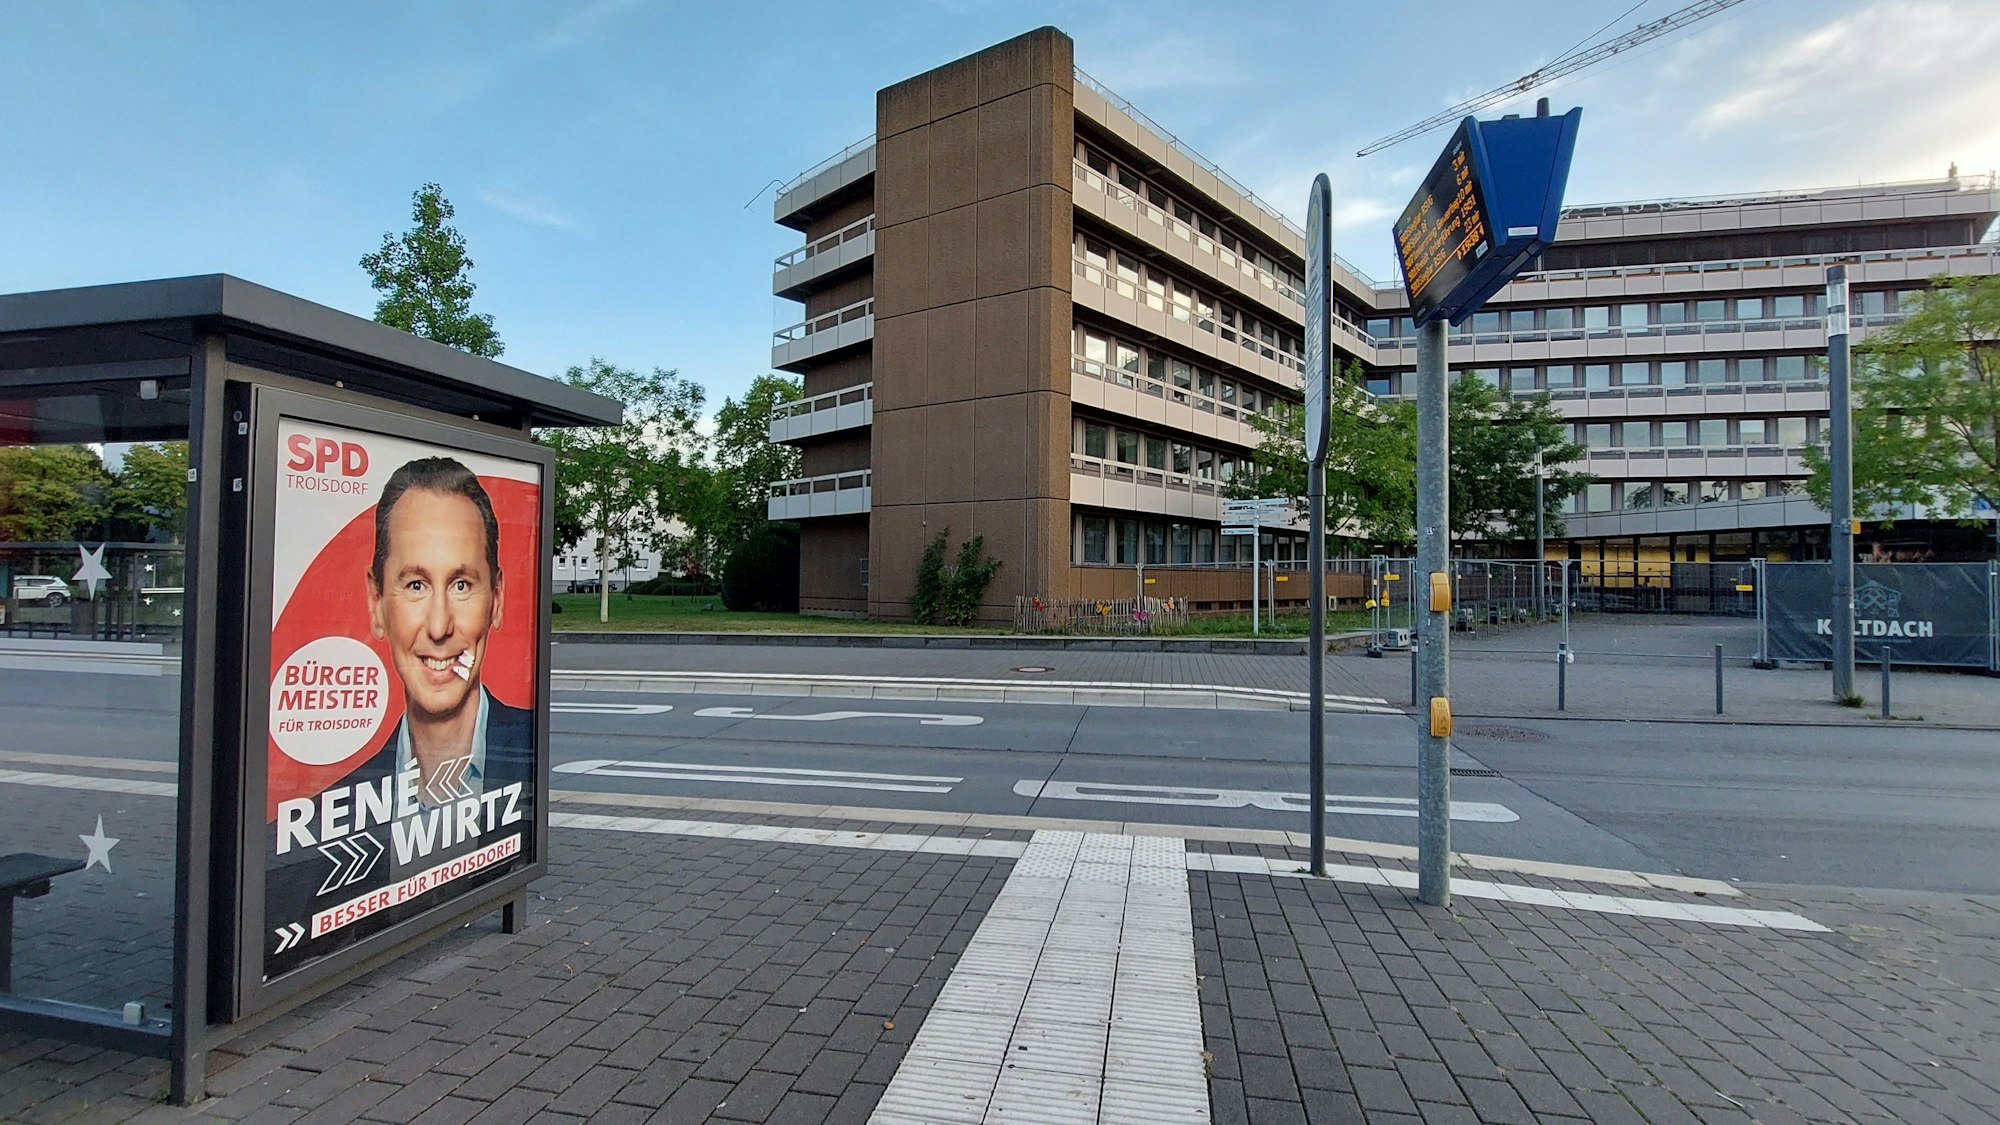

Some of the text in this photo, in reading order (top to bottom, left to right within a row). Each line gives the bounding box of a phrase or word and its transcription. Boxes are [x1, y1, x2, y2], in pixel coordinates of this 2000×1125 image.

[287, 434, 369, 478] SPD
[286, 474, 369, 495] TROISDORF
[1816, 618, 1934, 638] KTDACH
[284, 660, 379, 686] BÜRGER
[277, 690, 379, 711] MEISTER
[279, 718, 373, 733] FÜR TROISDORF
[276, 757, 421, 855] RENÉ
[391, 781, 522, 866] WIRTZ
[319, 891, 390, 934] BESSER
[397, 877, 428, 903] FÜR
[431, 838, 516, 889] TROISDORF!
